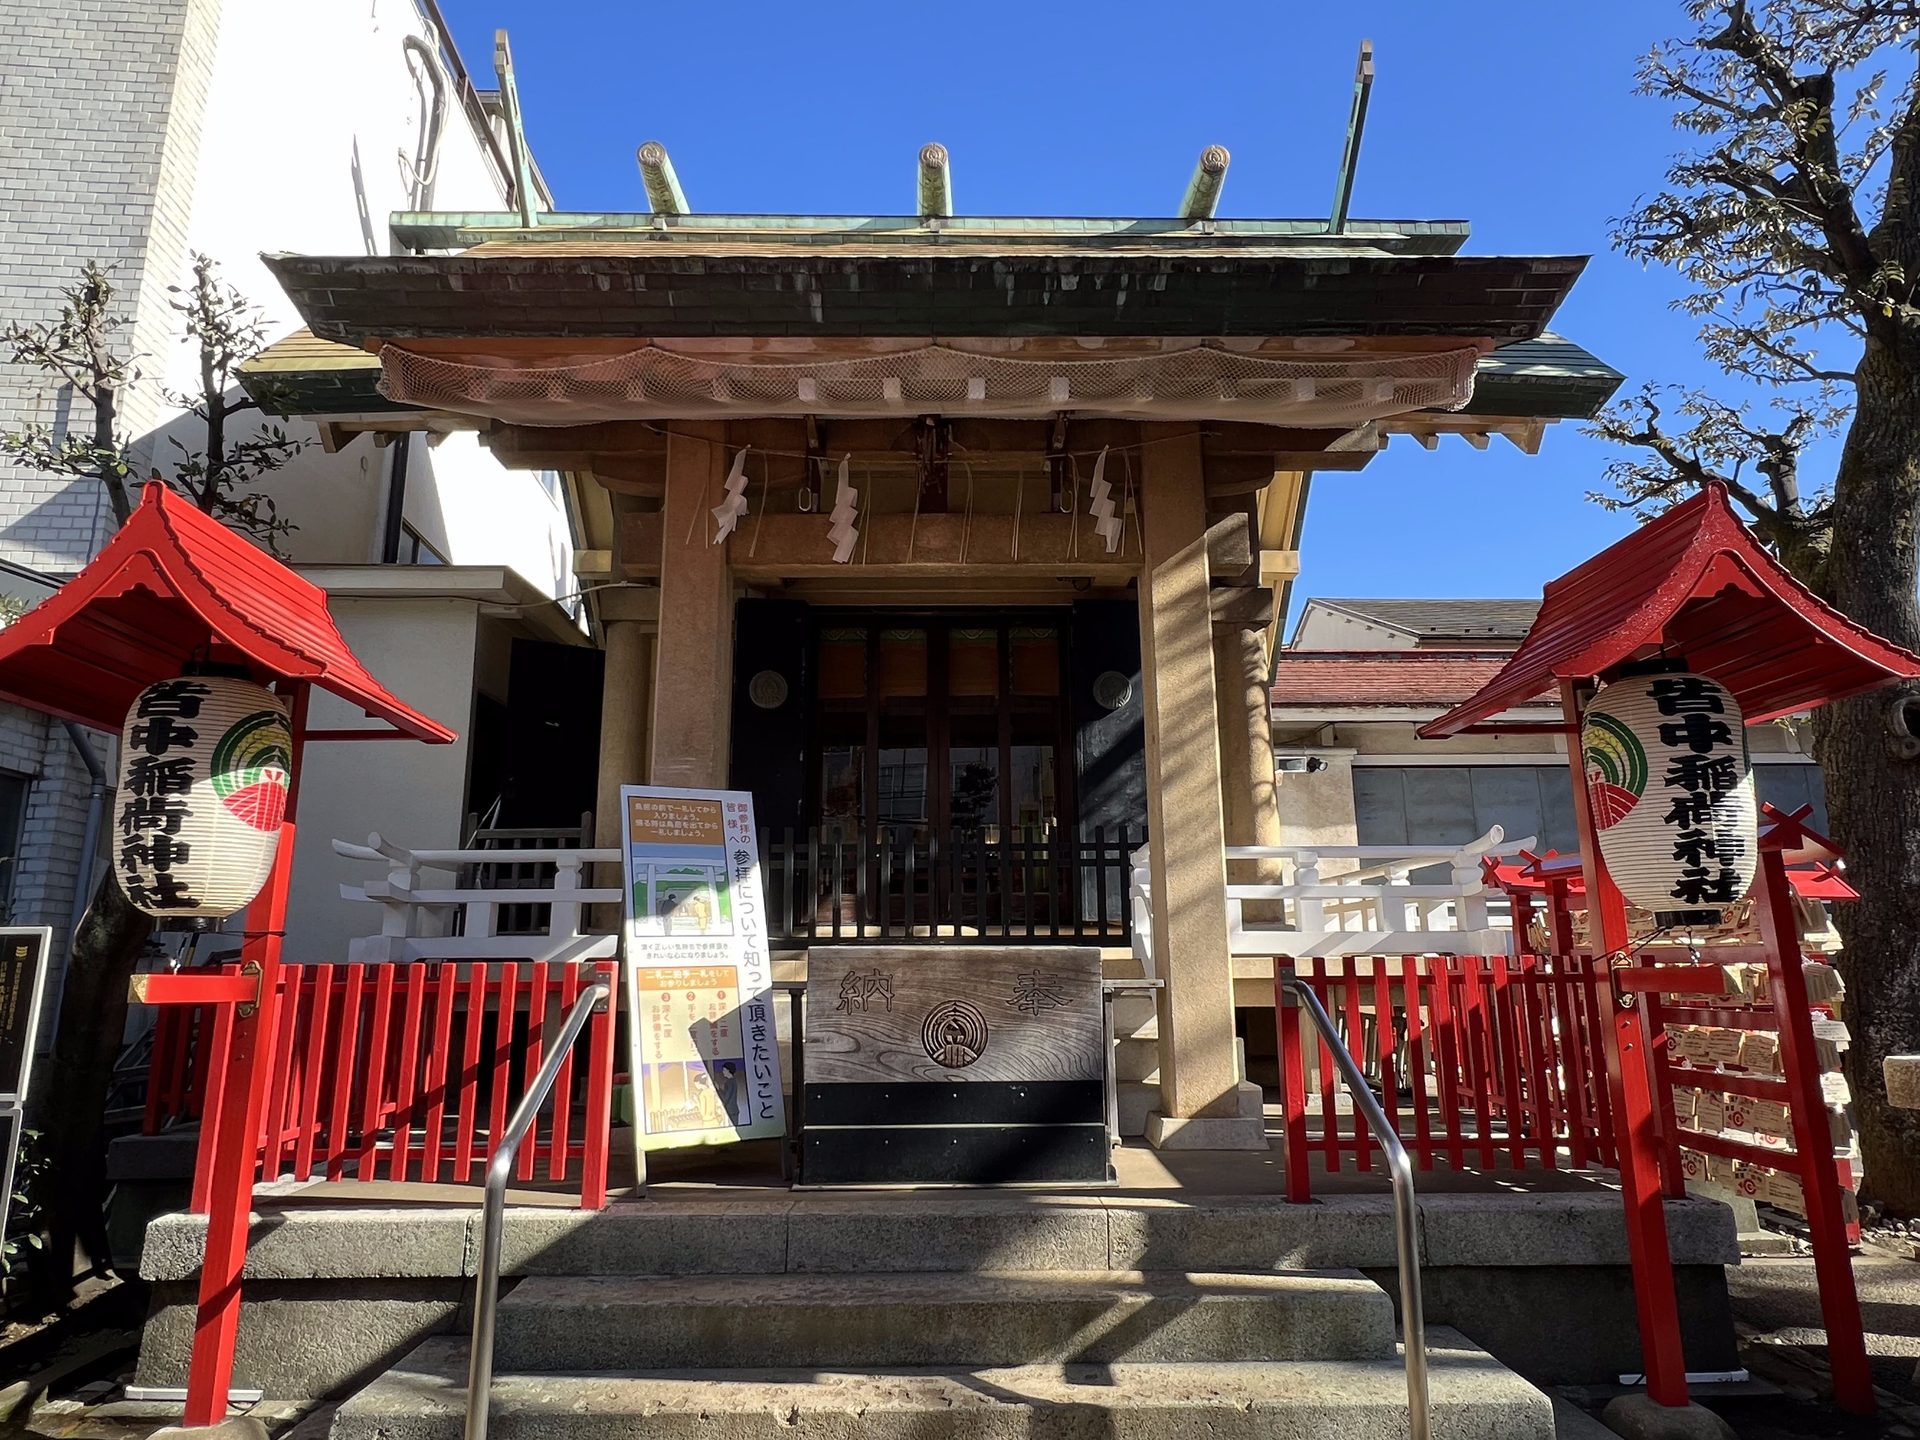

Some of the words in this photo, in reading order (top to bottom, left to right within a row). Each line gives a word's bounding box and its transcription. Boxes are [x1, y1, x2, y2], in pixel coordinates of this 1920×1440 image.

[119, 681, 212, 909] 皆中稲荷神社
[1646, 677, 1745, 903] 皆中稲荷神社
[726, 802, 740, 843] 皆様へ
[737, 802, 751, 844] 御参拝の
[733, 849, 775, 1119] 参拝について知って頂きたいこと
[836, 968, 896, 1015] 納
[1006, 968, 1073, 1016] 奉
